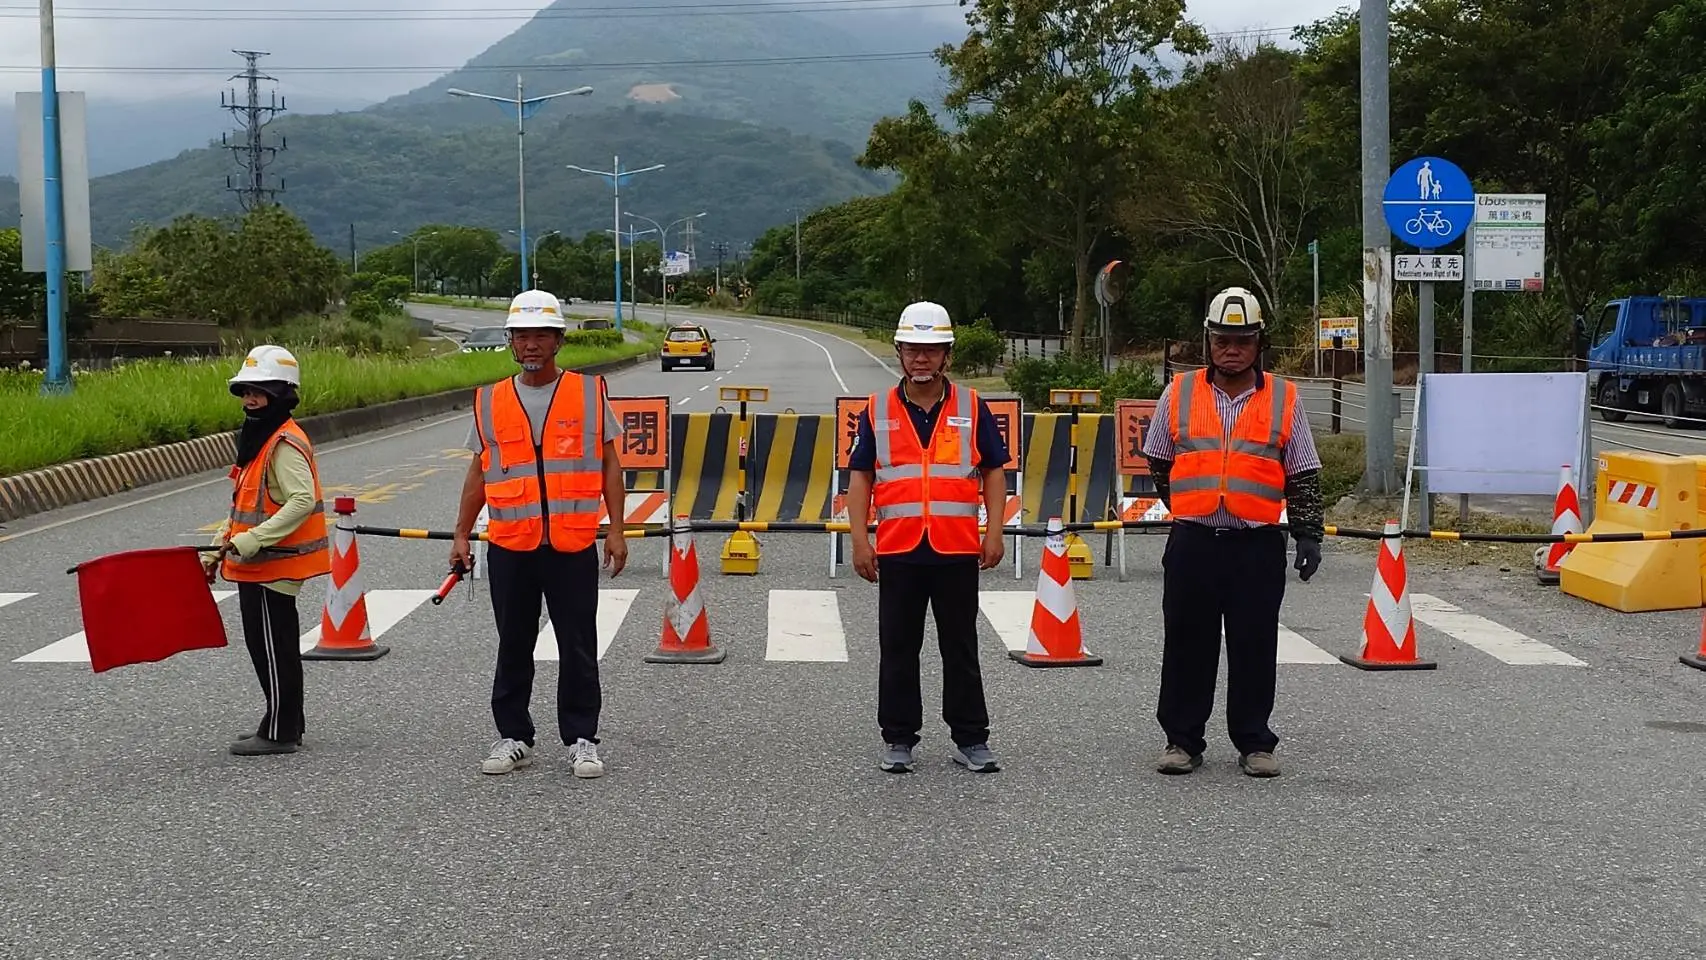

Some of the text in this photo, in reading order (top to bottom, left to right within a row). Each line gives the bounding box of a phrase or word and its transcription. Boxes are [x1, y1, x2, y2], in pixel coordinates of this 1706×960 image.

[1479, 196, 1506, 206] Ubus
[1397, 257, 1459, 269] 行人優先
[622, 411, 658, 455] 閉
